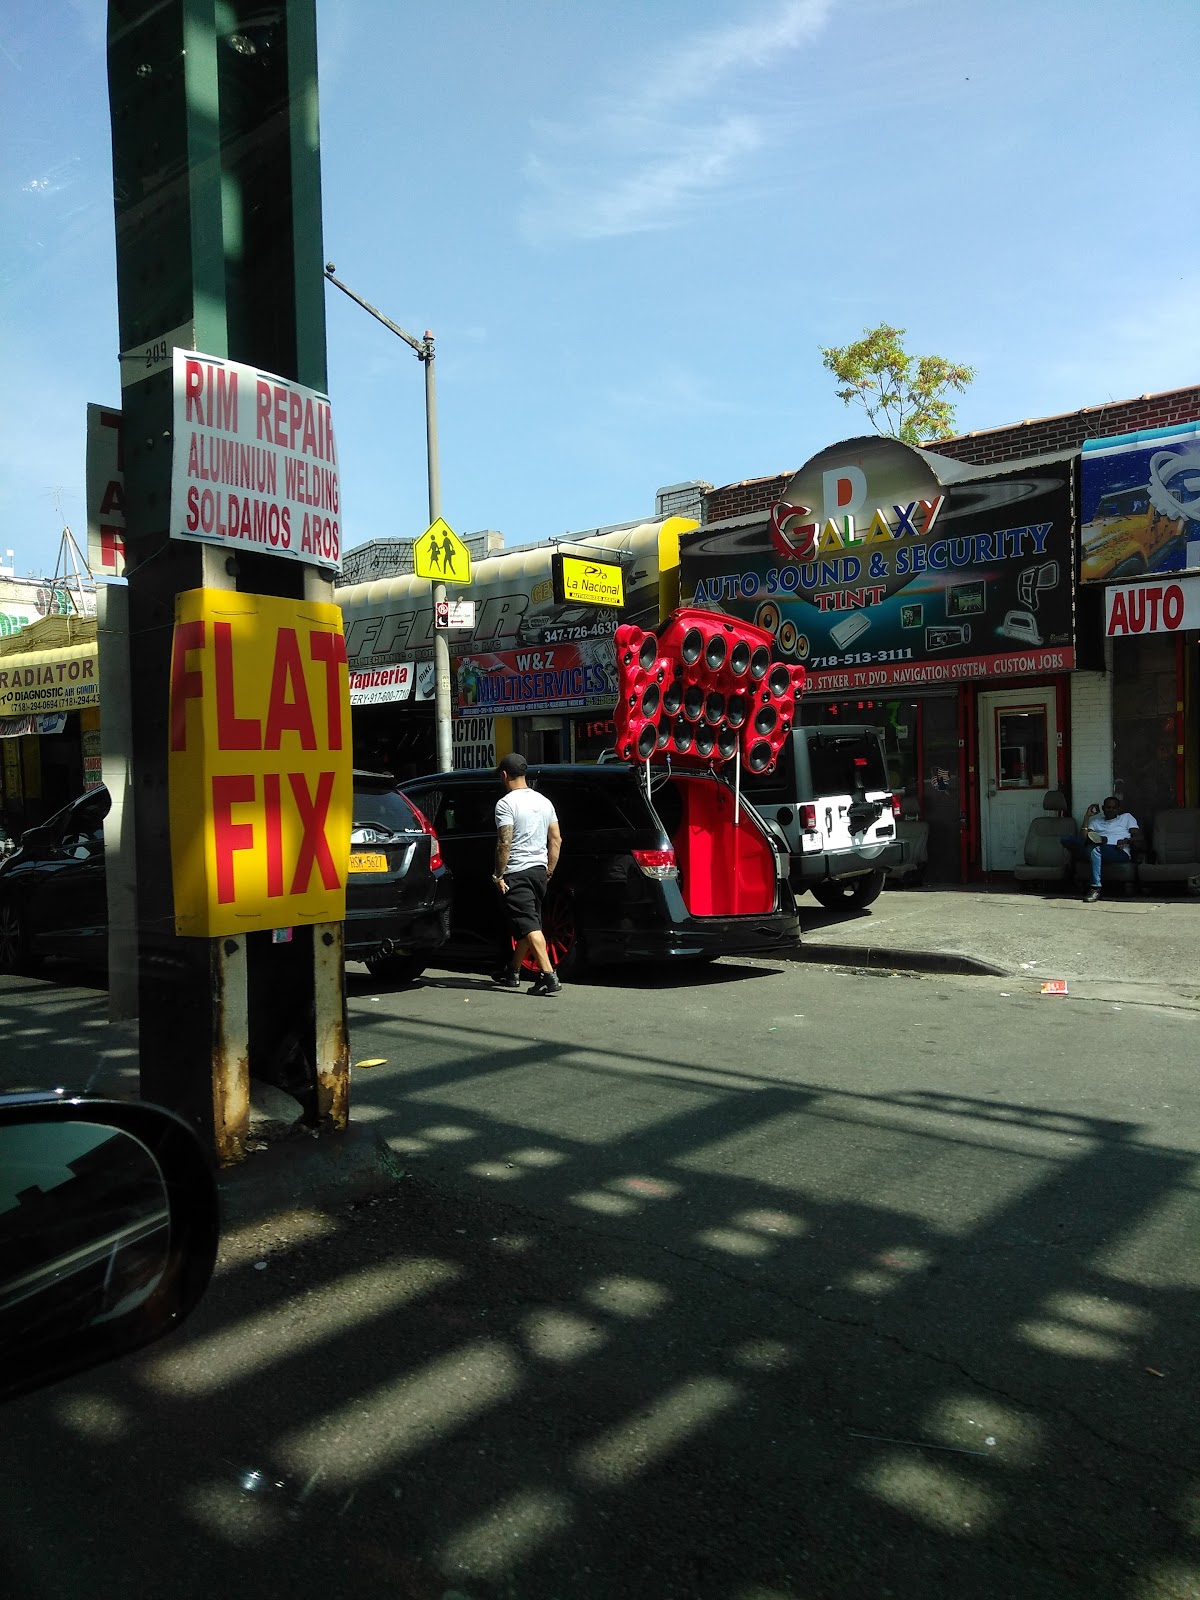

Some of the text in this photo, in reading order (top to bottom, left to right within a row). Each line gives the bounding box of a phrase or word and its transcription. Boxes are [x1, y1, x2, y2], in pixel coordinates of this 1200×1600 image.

[145, 340, 168, 369] 209
[185, 360, 336, 466] RIM REPAIR
[187, 431, 339, 515] ALUMINIUN WELDING
[185, 485, 340, 562] SOLDAMOS AROS
[769, 495, 946, 562] GALAXY
[692, 521, 1054, 605] AUTO SOUND & SECURITY
[566, 576, 620, 596] La Nacional
[813, 585, 887, 614] TINT
[1107, 584, 1185, 636] AUTO
[544, 620, 620, 643] 347-726-4630
[0, 659, 94, 689] RADIATOR
[418, 662, 434, 684] MIKE
[515, 651, 556, 672] W&Z
[810, 647, 914, 669] 718-513-3111
[817, 674, 850, 690] STYKER
[868, 671, 888, 685] DVD
[893, 664, 950, 683] NAVIGATION
[951, 661, 988, 678] SYSTEM
[993, 656, 1036, 674] CUSTOM
[1038, 653, 1064, 670] JOBS
[14, 686, 64, 702] DIAGNOSTIC
[64, 686, 75, 697] AIR
[170, 619, 349, 753] FLAT
[349, 665, 409, 690] Tapizeria
[475, 662, 606, 703] MULTISERVICES
[211, 771, 342, 905] FIX
